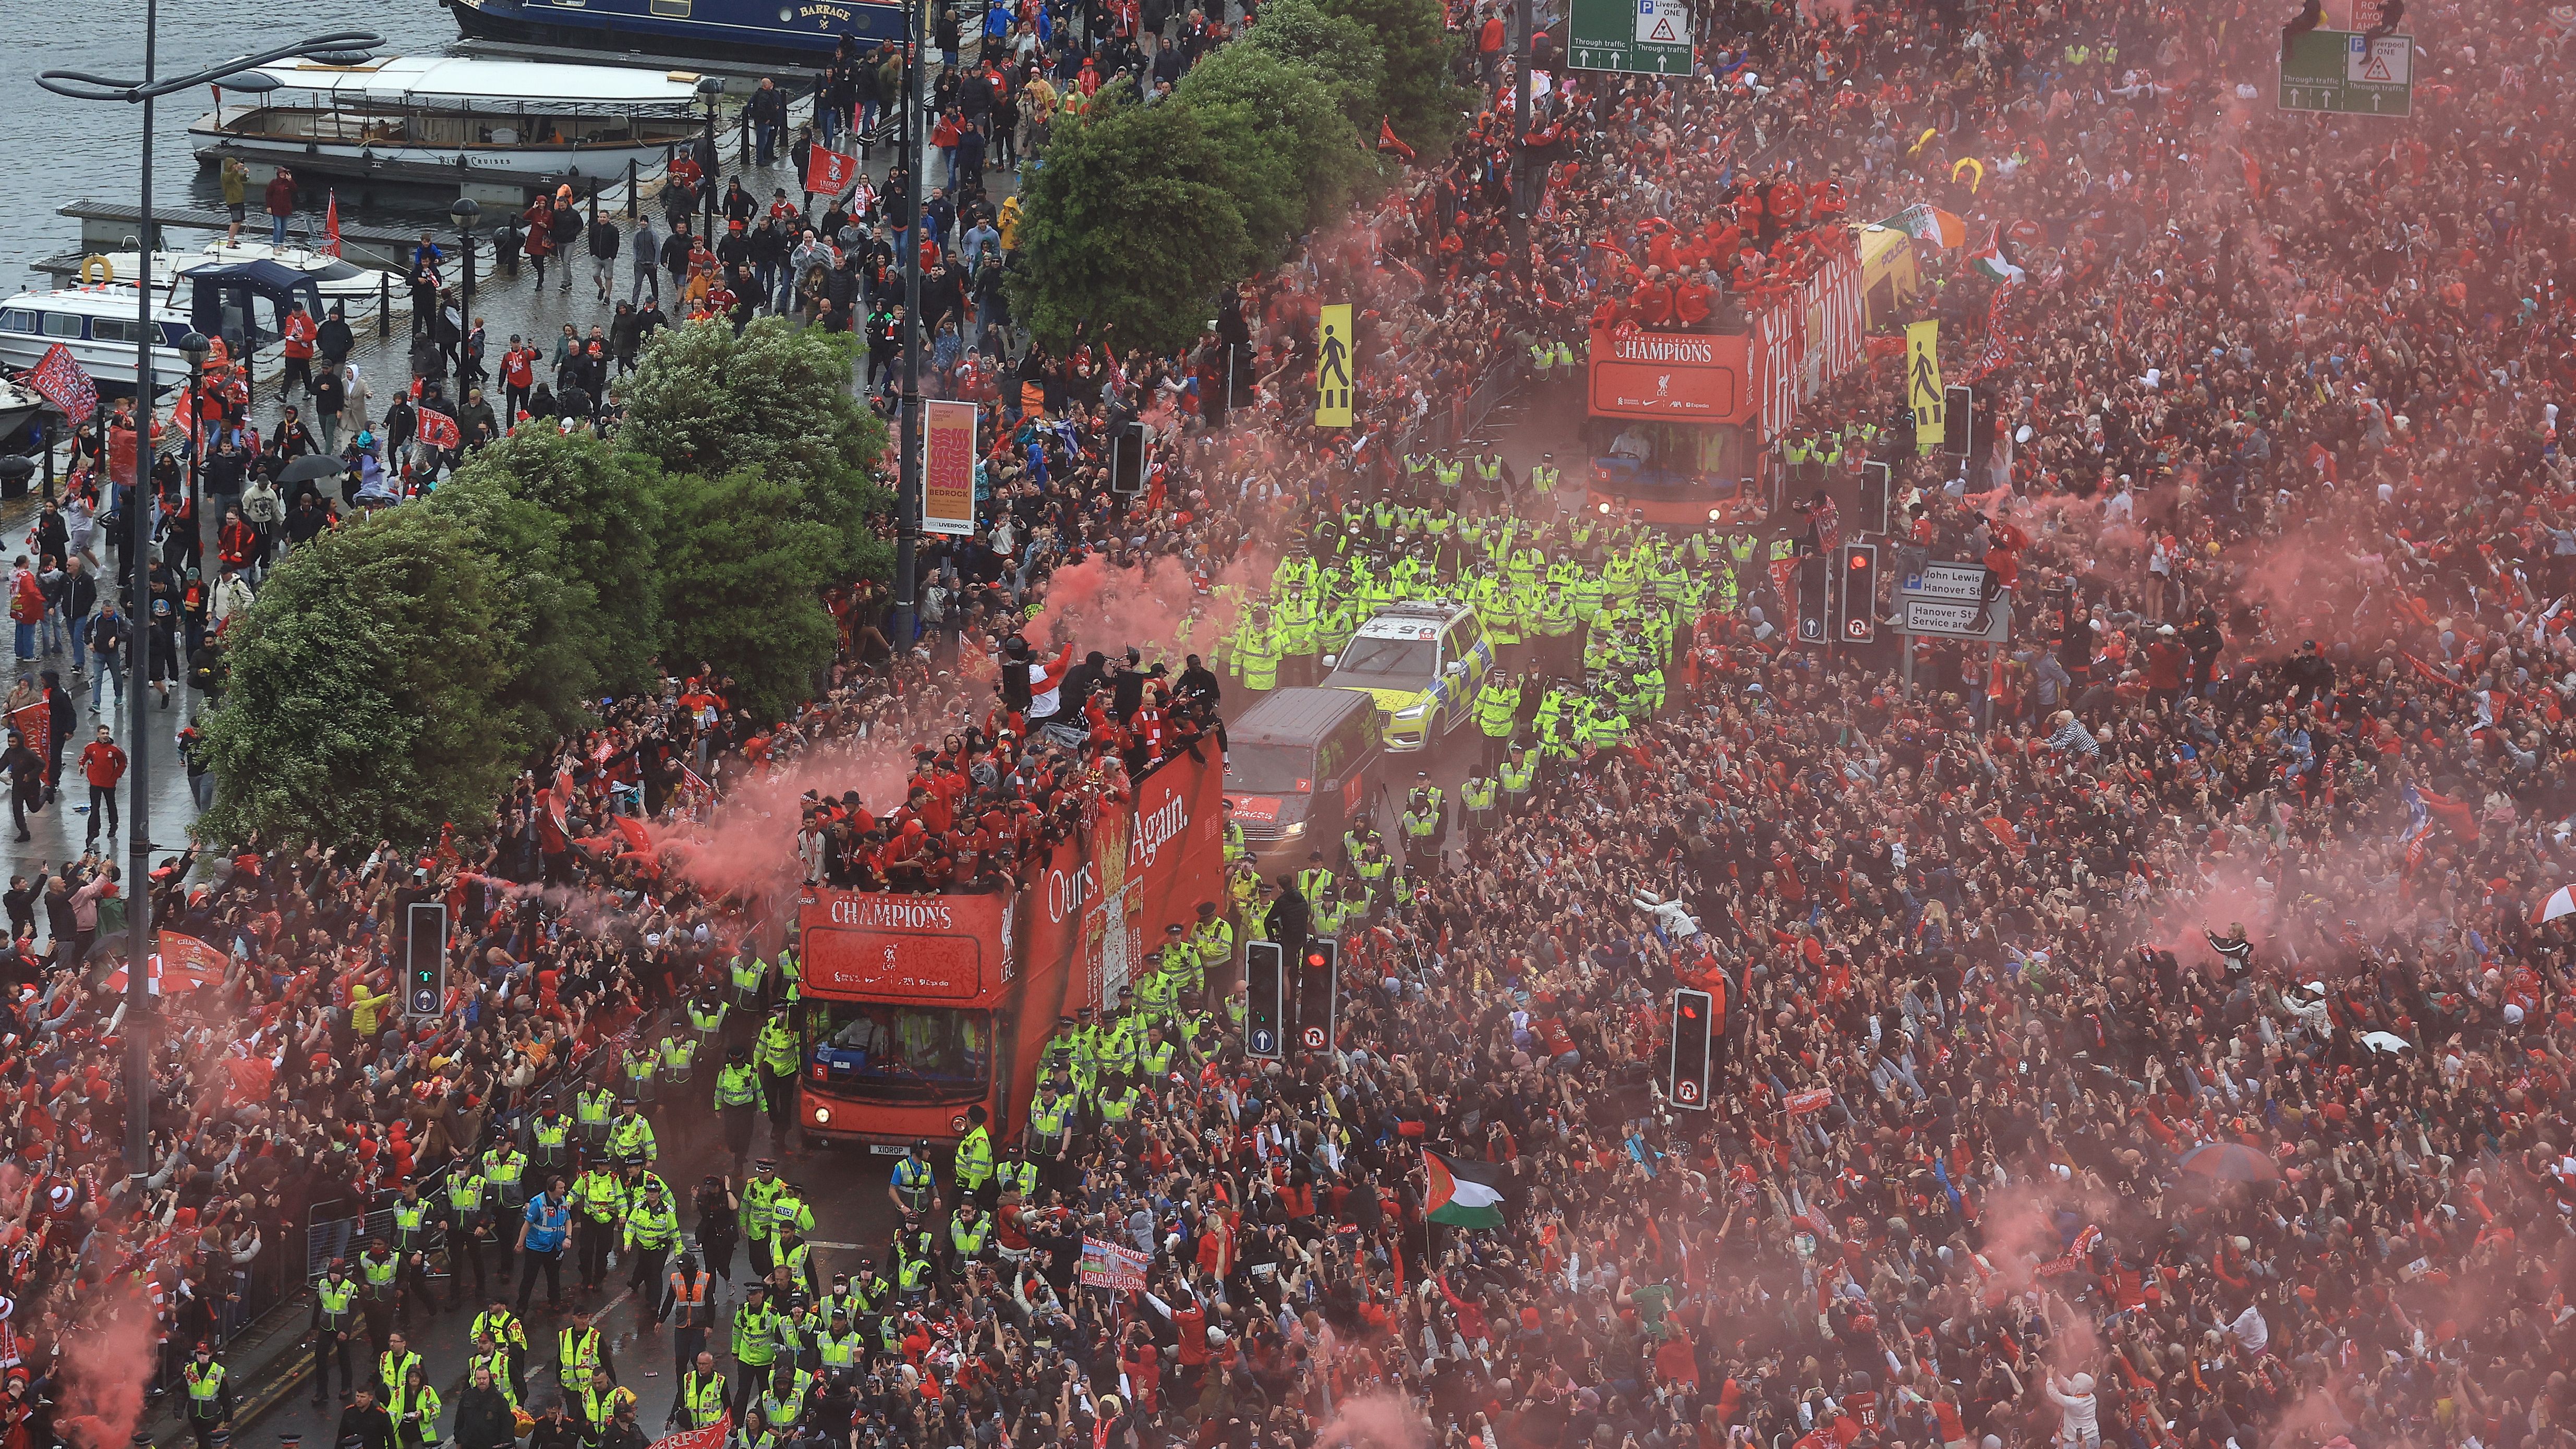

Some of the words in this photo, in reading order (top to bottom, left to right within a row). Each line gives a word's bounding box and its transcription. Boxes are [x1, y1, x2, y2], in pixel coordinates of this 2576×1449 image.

[800, 4, 851, 22] BARRAGE
[1575, 38, 1603, 47] Through
[1605, 40, 1626, 49] traffic
[1637, 44, 1665, 53] Through
[1667, 46, 1688, 54] traffic
[2284, 76, 2313, 84] Through
[2316, 76, 2339, 84] traffic
[2350, 83, 2378, 91] Through
[2380, 84, 2405, 93] traffic
[1882, 236, 1909, 268] POLICE
[1616, 341, 1711, 363] CHAMPIONS
[929, 489, 968, 498] BEDROCK
[1925, 570, 1948, 580] John
[1952, 572, 1980, 583] Lewis
[1925, 583, 1965, 595] Hanover
[1915, 606, 1957, 618] Hanover
[1912, 615, 1950, 626] Service
[1235, 810, 1273, 820] PRESS
[1048, 861, 1098, 924] Ours.
[1130, 787, 1189, 868] Again.
[840, 895, 889, 904] PREIER
[831, 900, 952, 930] CHAMPIONS
[817, 1068, 823, 1077] 5
[776, 1206, 793, 1217] POLICE
[1083, 1235, 1147, 1262] LIVERPOOL
[1861, 1409, 1876, 1426] 10
